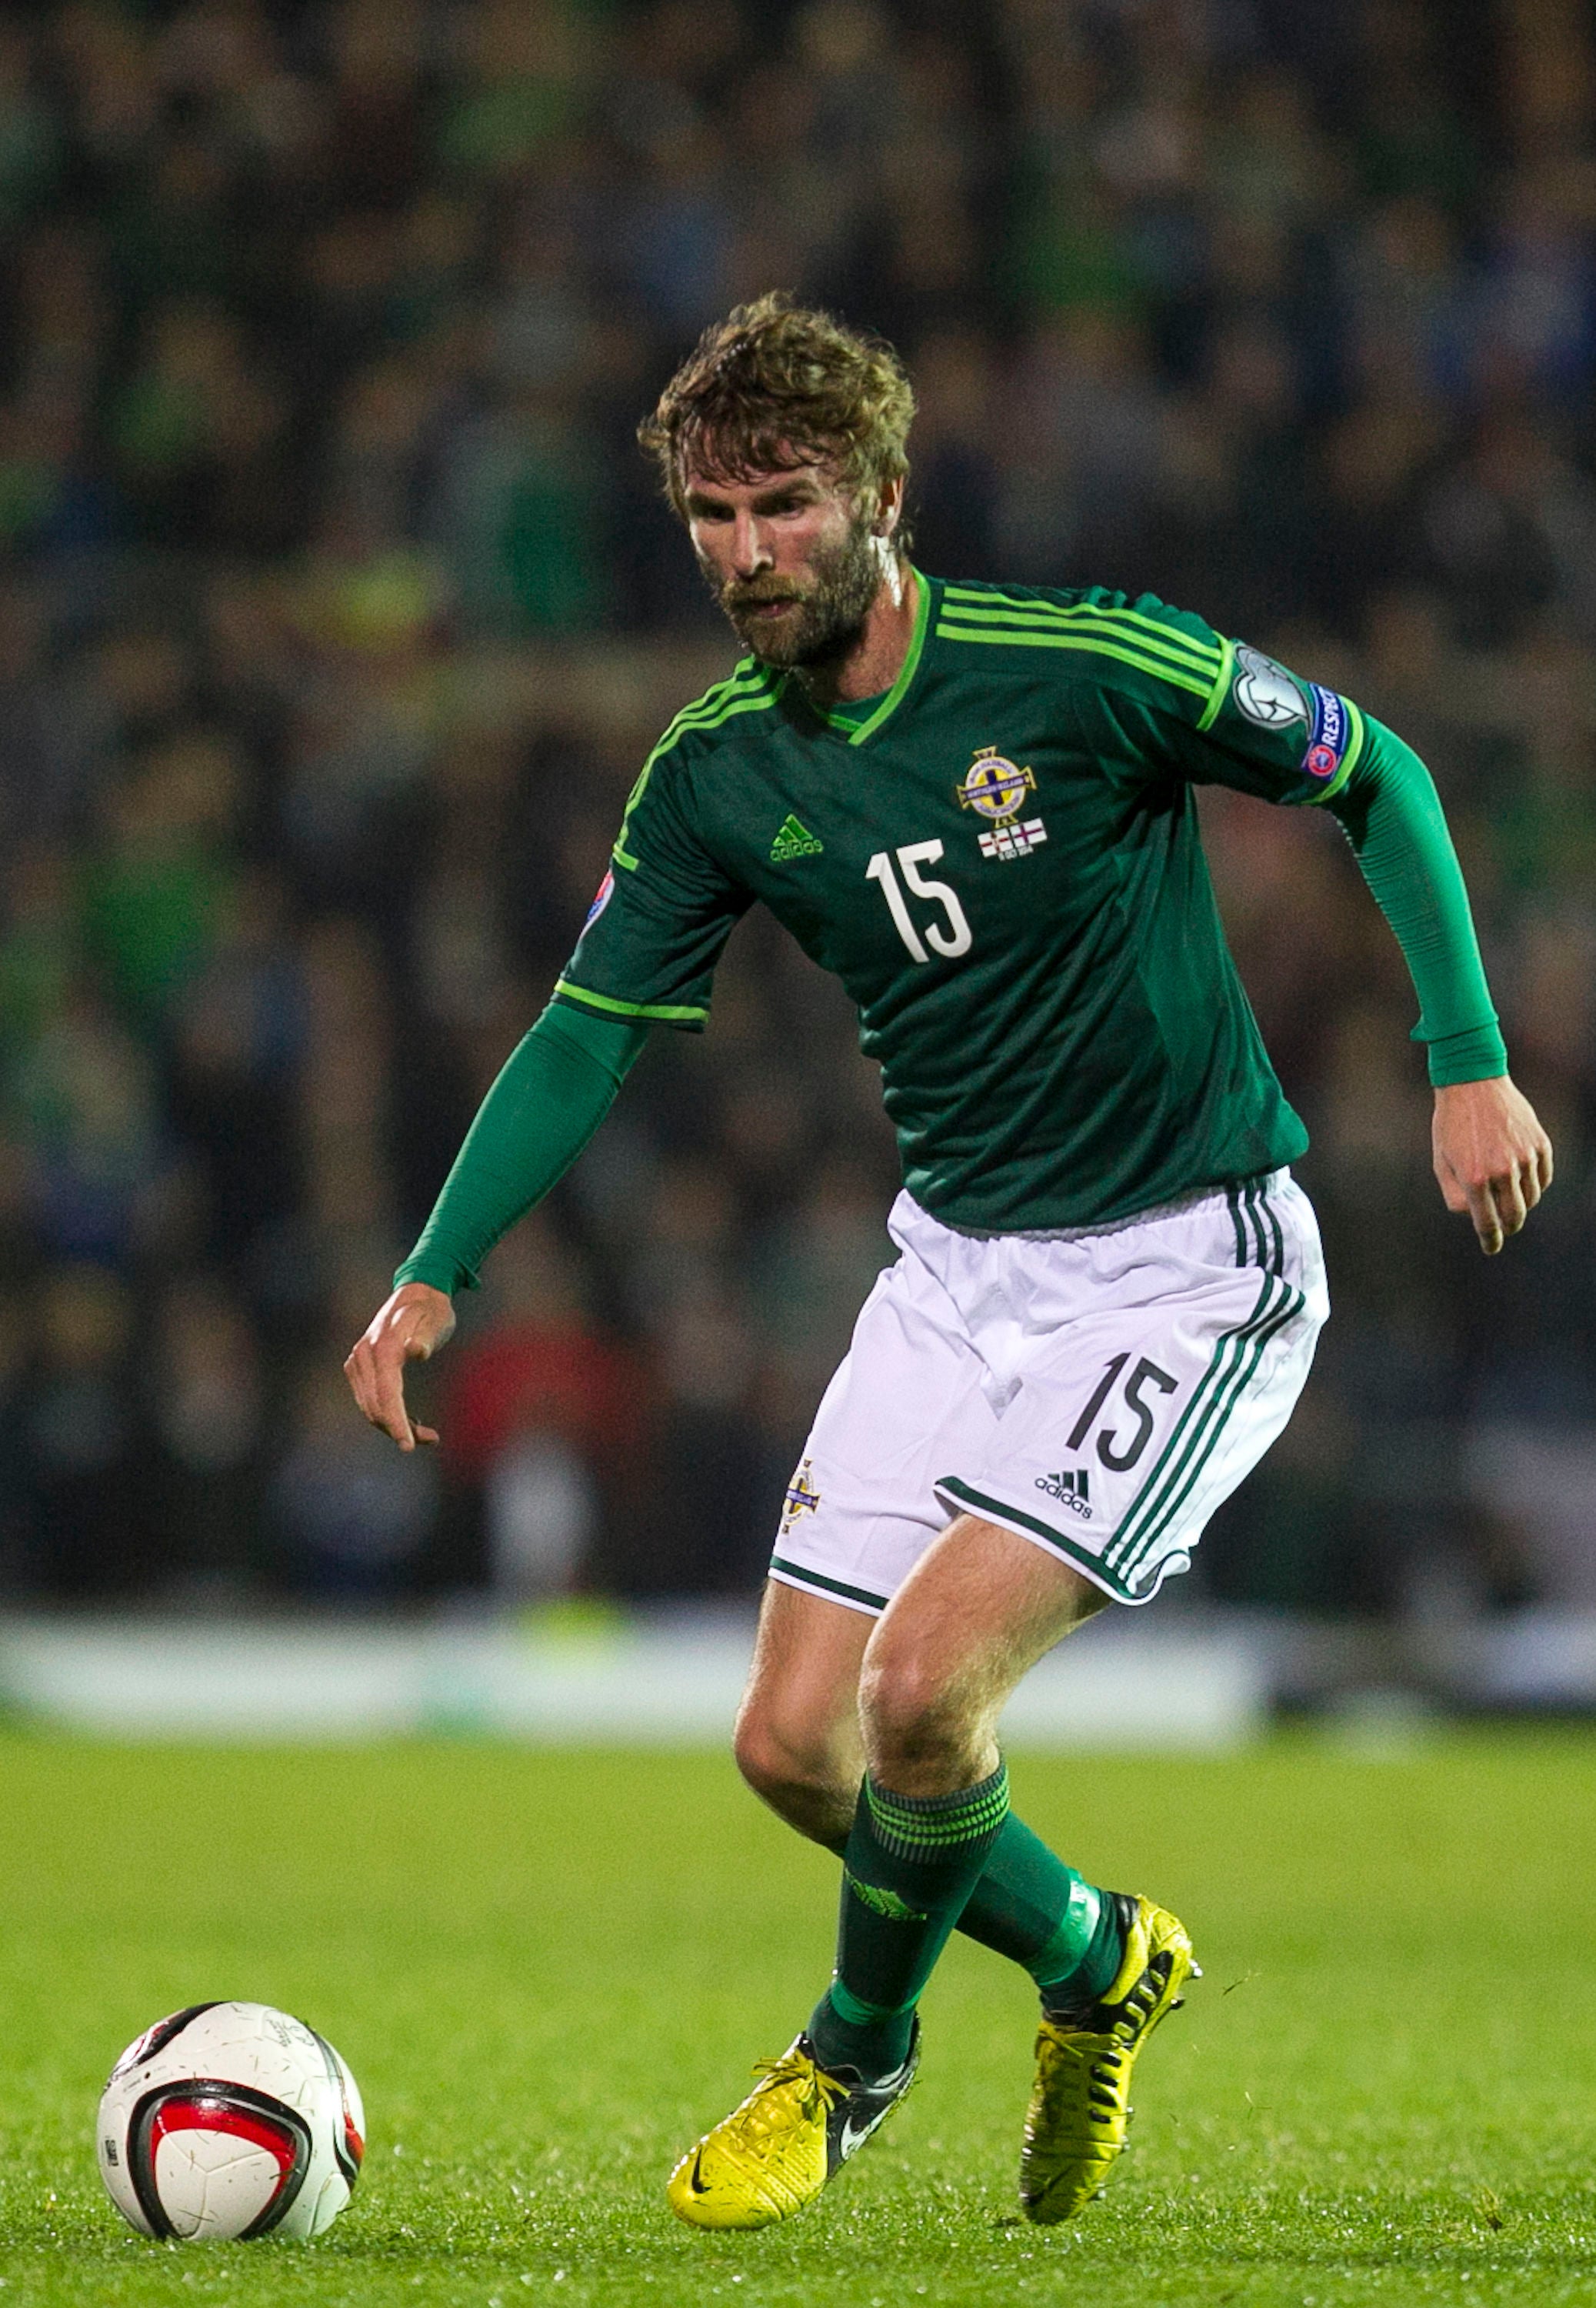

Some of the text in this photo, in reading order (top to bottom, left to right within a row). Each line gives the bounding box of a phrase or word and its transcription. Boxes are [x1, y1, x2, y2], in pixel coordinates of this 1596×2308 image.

[770, 839, 824, 862] adidas
[865, 839, 973, 963] 15
[1065, 1352, 1180, 1473] 15
[1035, 1477, 1093, 1519] adidas
